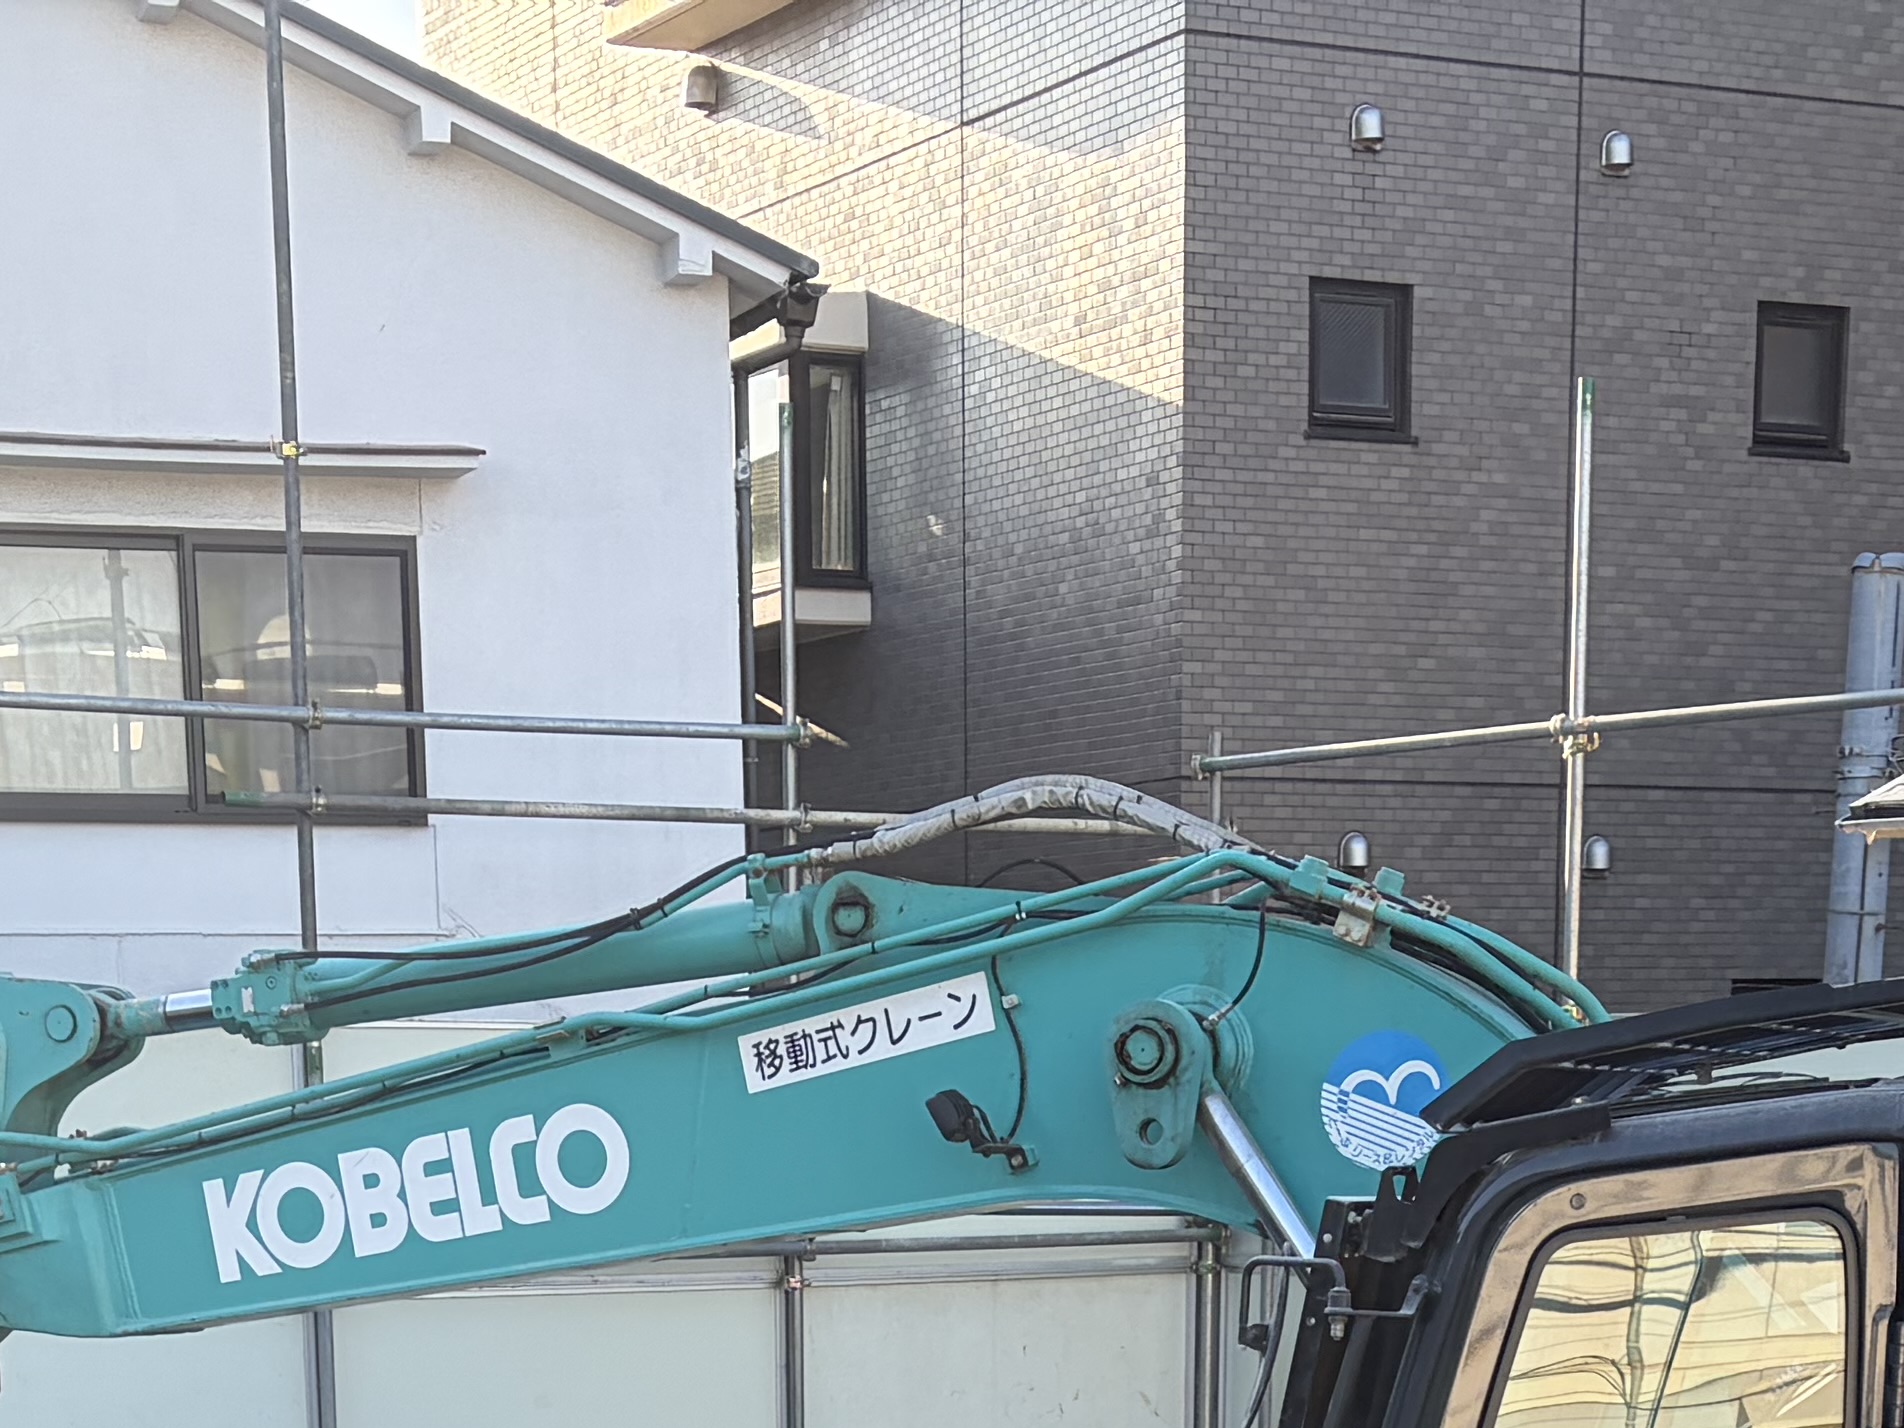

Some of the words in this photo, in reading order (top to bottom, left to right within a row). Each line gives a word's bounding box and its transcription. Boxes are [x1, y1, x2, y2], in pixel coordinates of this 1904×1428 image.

[751, 992, 977, 1081] 移動式クレーン
[202, 1103, 630, 1284] KOBELCO
